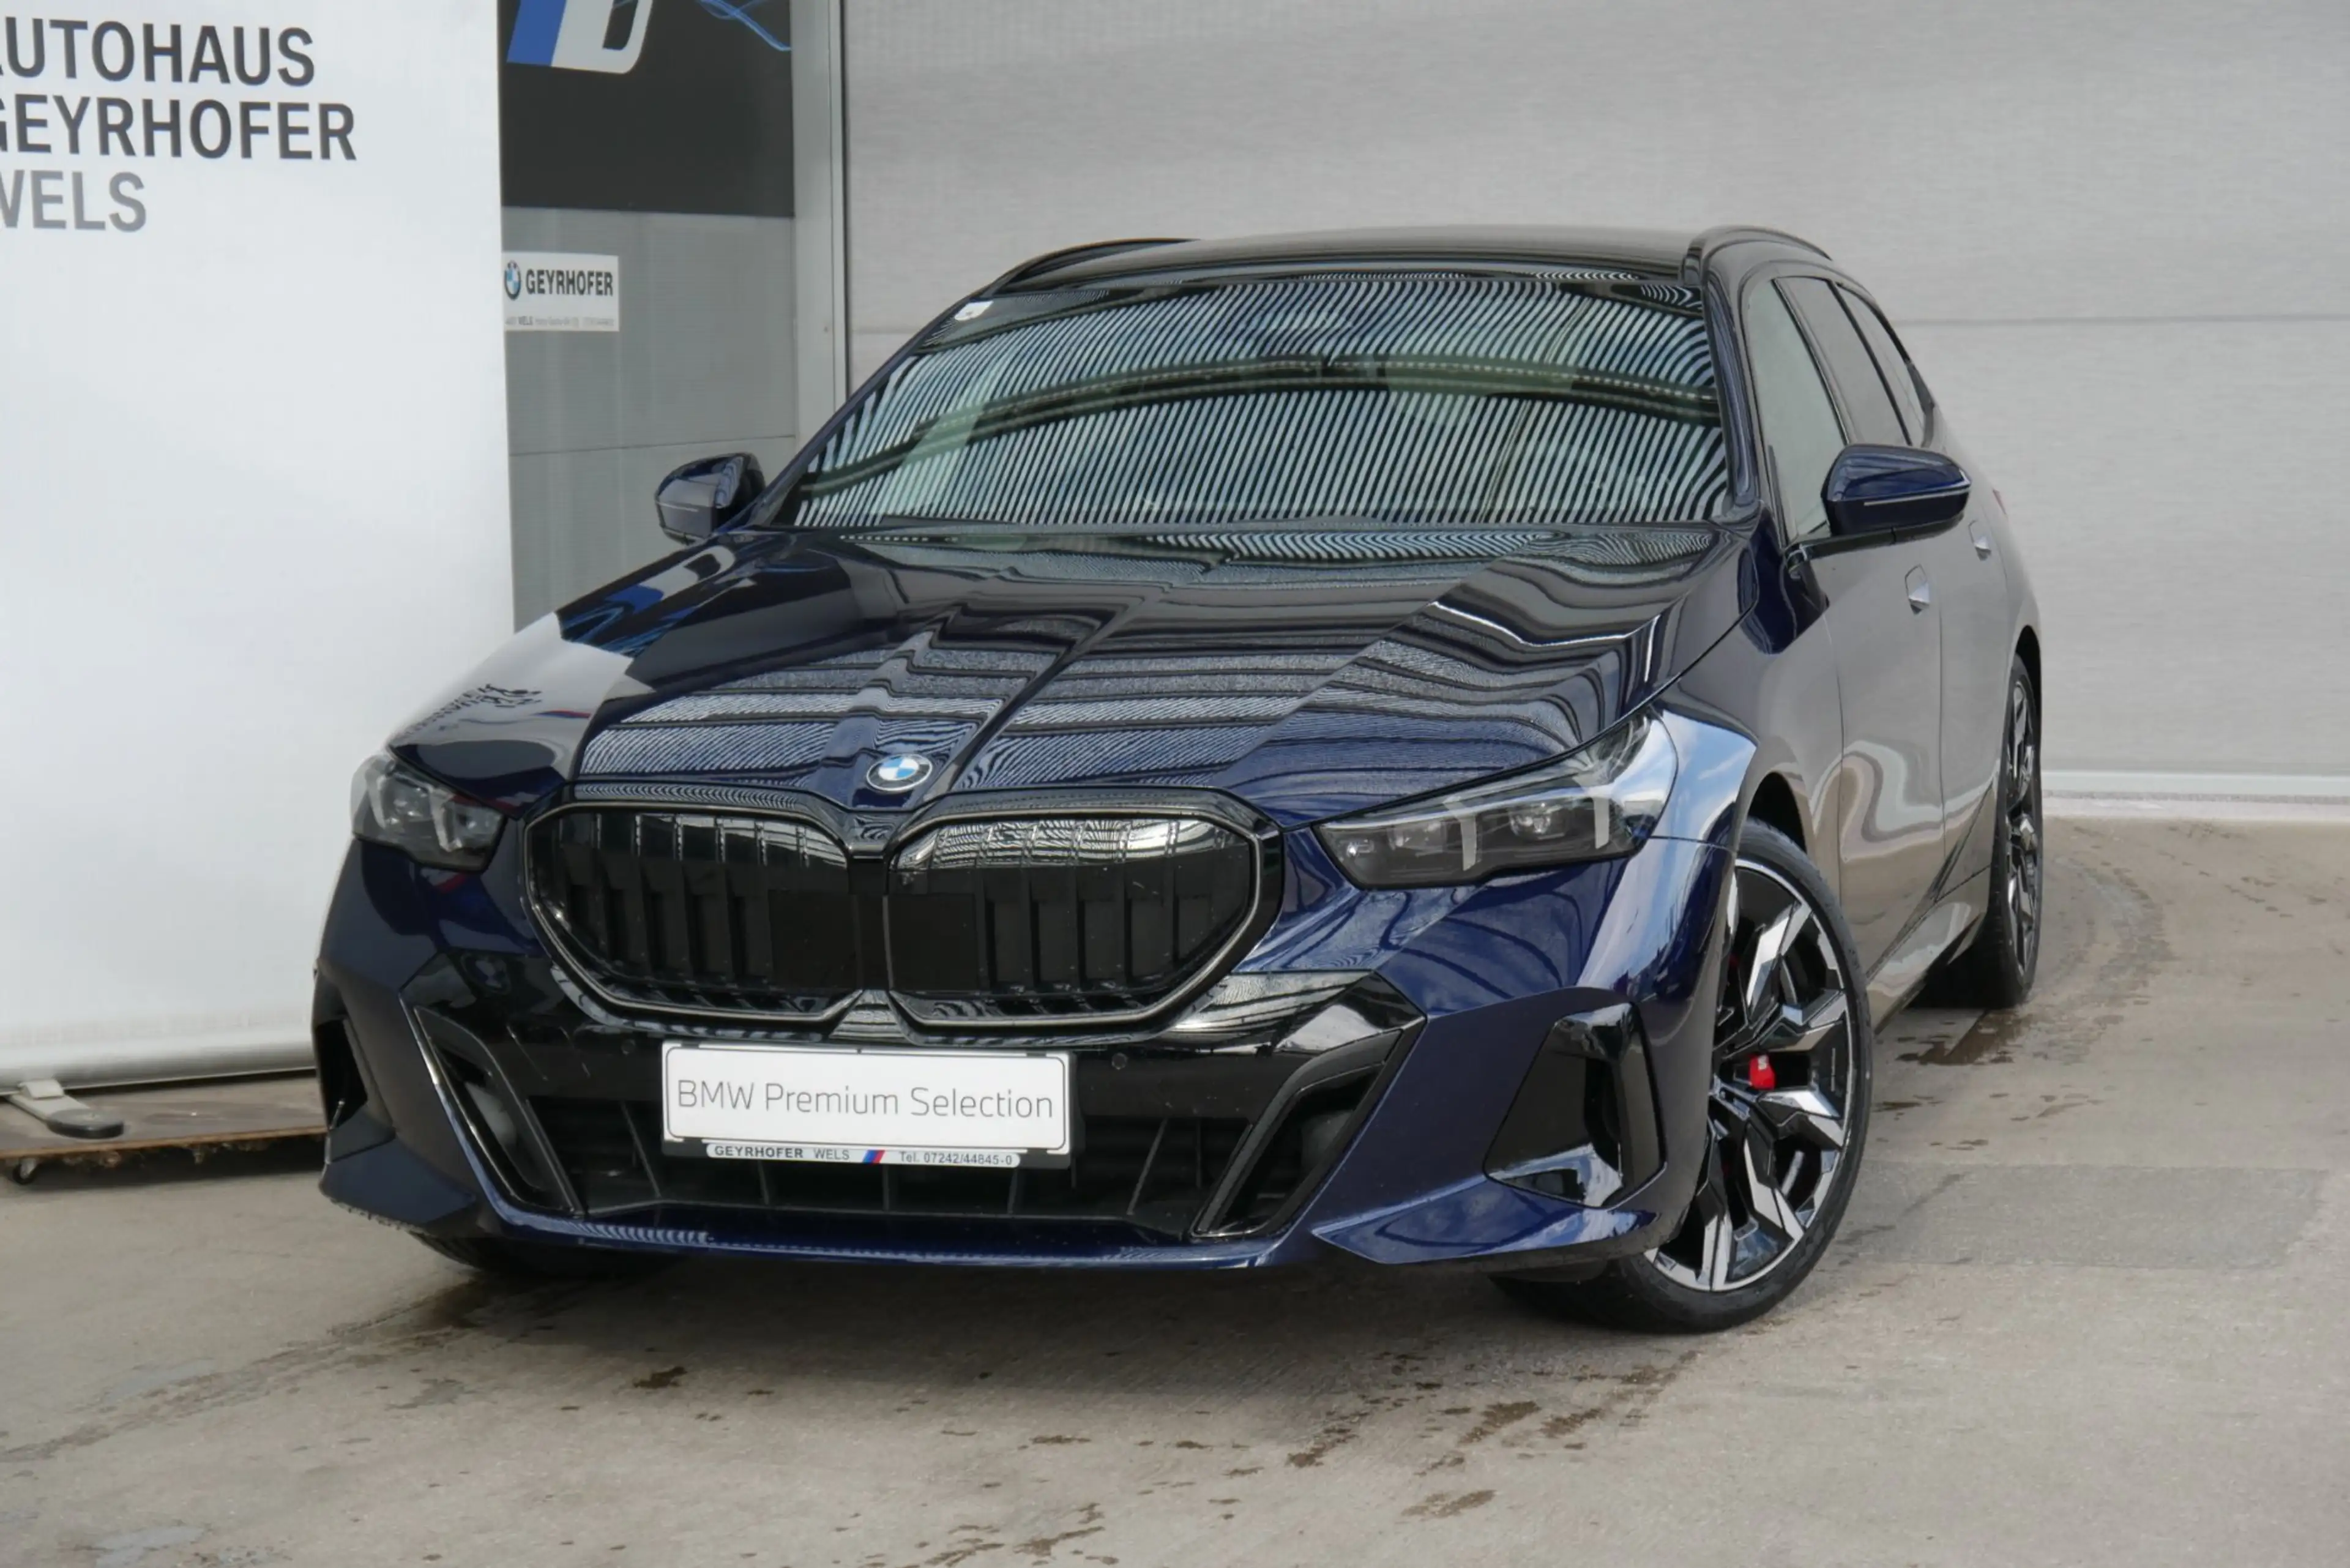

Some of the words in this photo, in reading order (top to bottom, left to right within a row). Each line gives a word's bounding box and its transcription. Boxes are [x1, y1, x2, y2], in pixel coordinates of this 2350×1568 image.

[0, 17, 315, 87] UTOHAUS
[0, 94, 357, 160] EYRHOFER
[526, 269, 613, 296] GEYRHOFER
[678, 1079, 754, 1110] BMW
[765, 1083, 898, 1115] Premium
[911, 1086, 1053, 1118] Selection
[714, 1145, 804, 1159] GEYRHOFER
[813, 1148, 850, 1160] WELS
